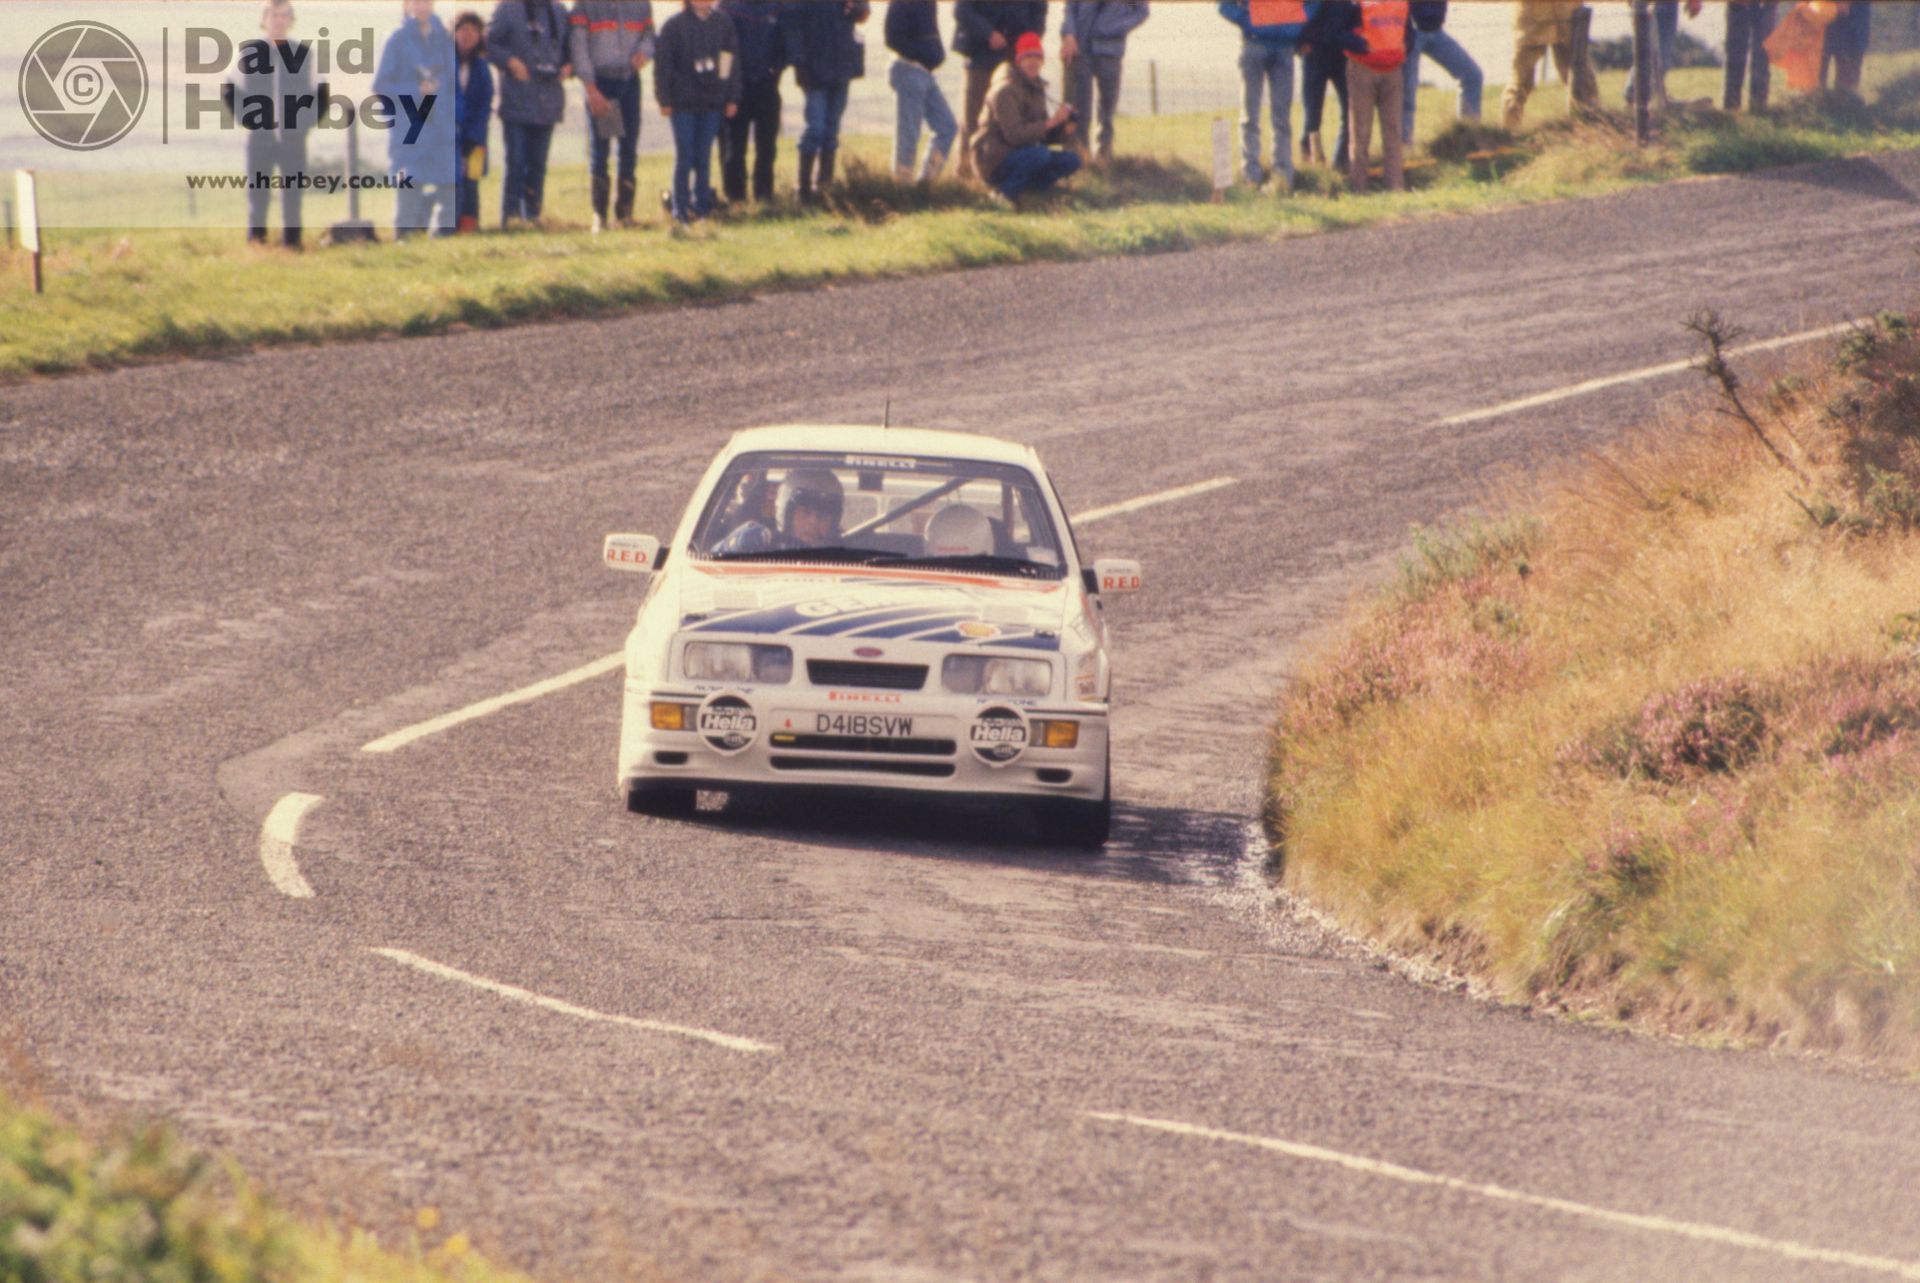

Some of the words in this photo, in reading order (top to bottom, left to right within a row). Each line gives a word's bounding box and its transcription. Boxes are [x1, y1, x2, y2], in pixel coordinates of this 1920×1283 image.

[704, 712, 754, 730] Hella
[816, 713, 913, 737] D418SVW
[974, 725, 1024, 742] Hella
